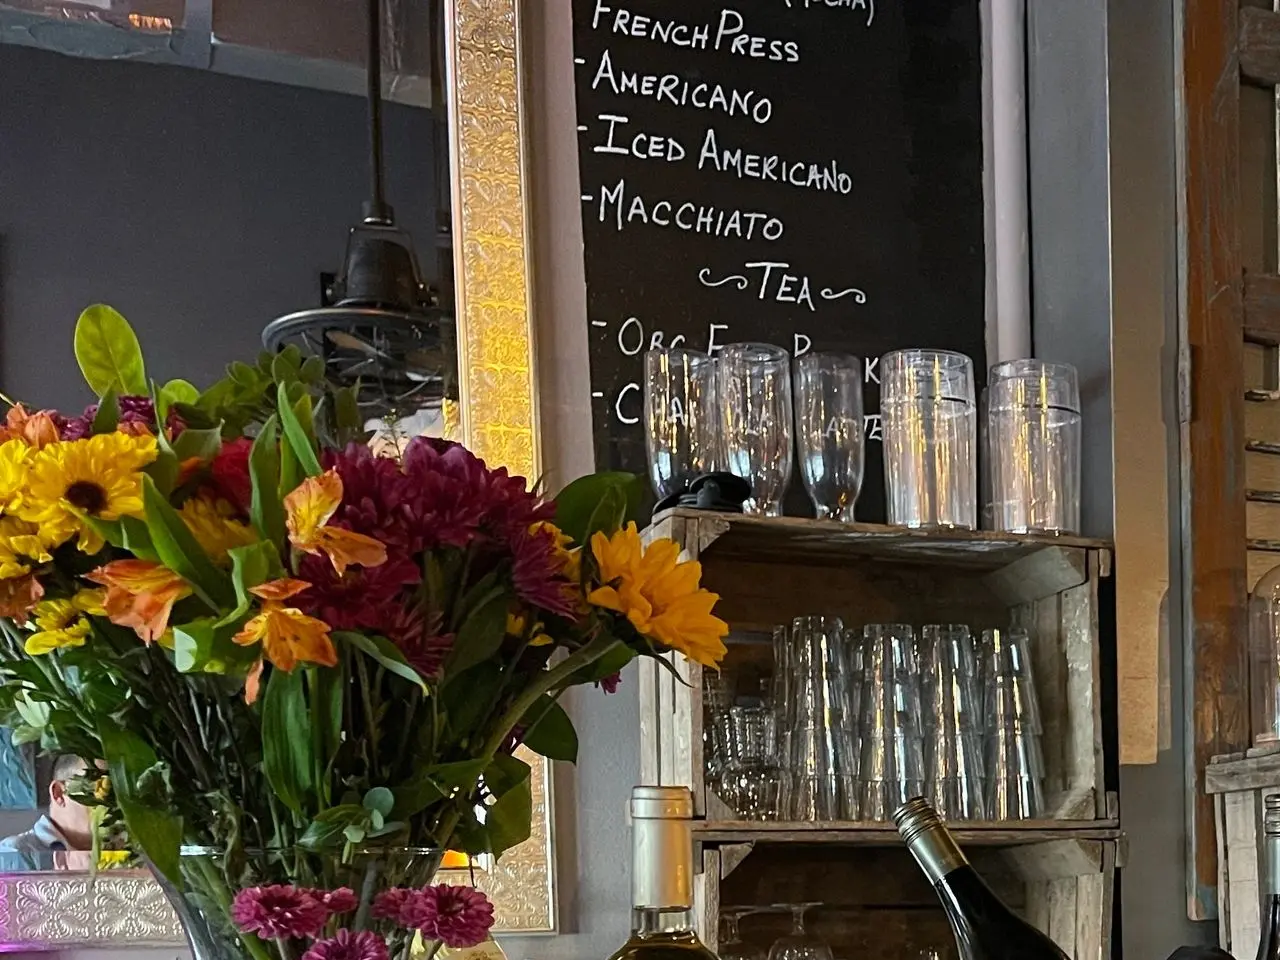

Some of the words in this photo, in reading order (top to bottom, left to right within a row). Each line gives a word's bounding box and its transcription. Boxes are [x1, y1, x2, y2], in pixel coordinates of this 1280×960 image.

[714, 9, 800, 62] PRESS
[699, 129, 852, 194] AMERICANO
[745, 262, 816, 311] TEA
